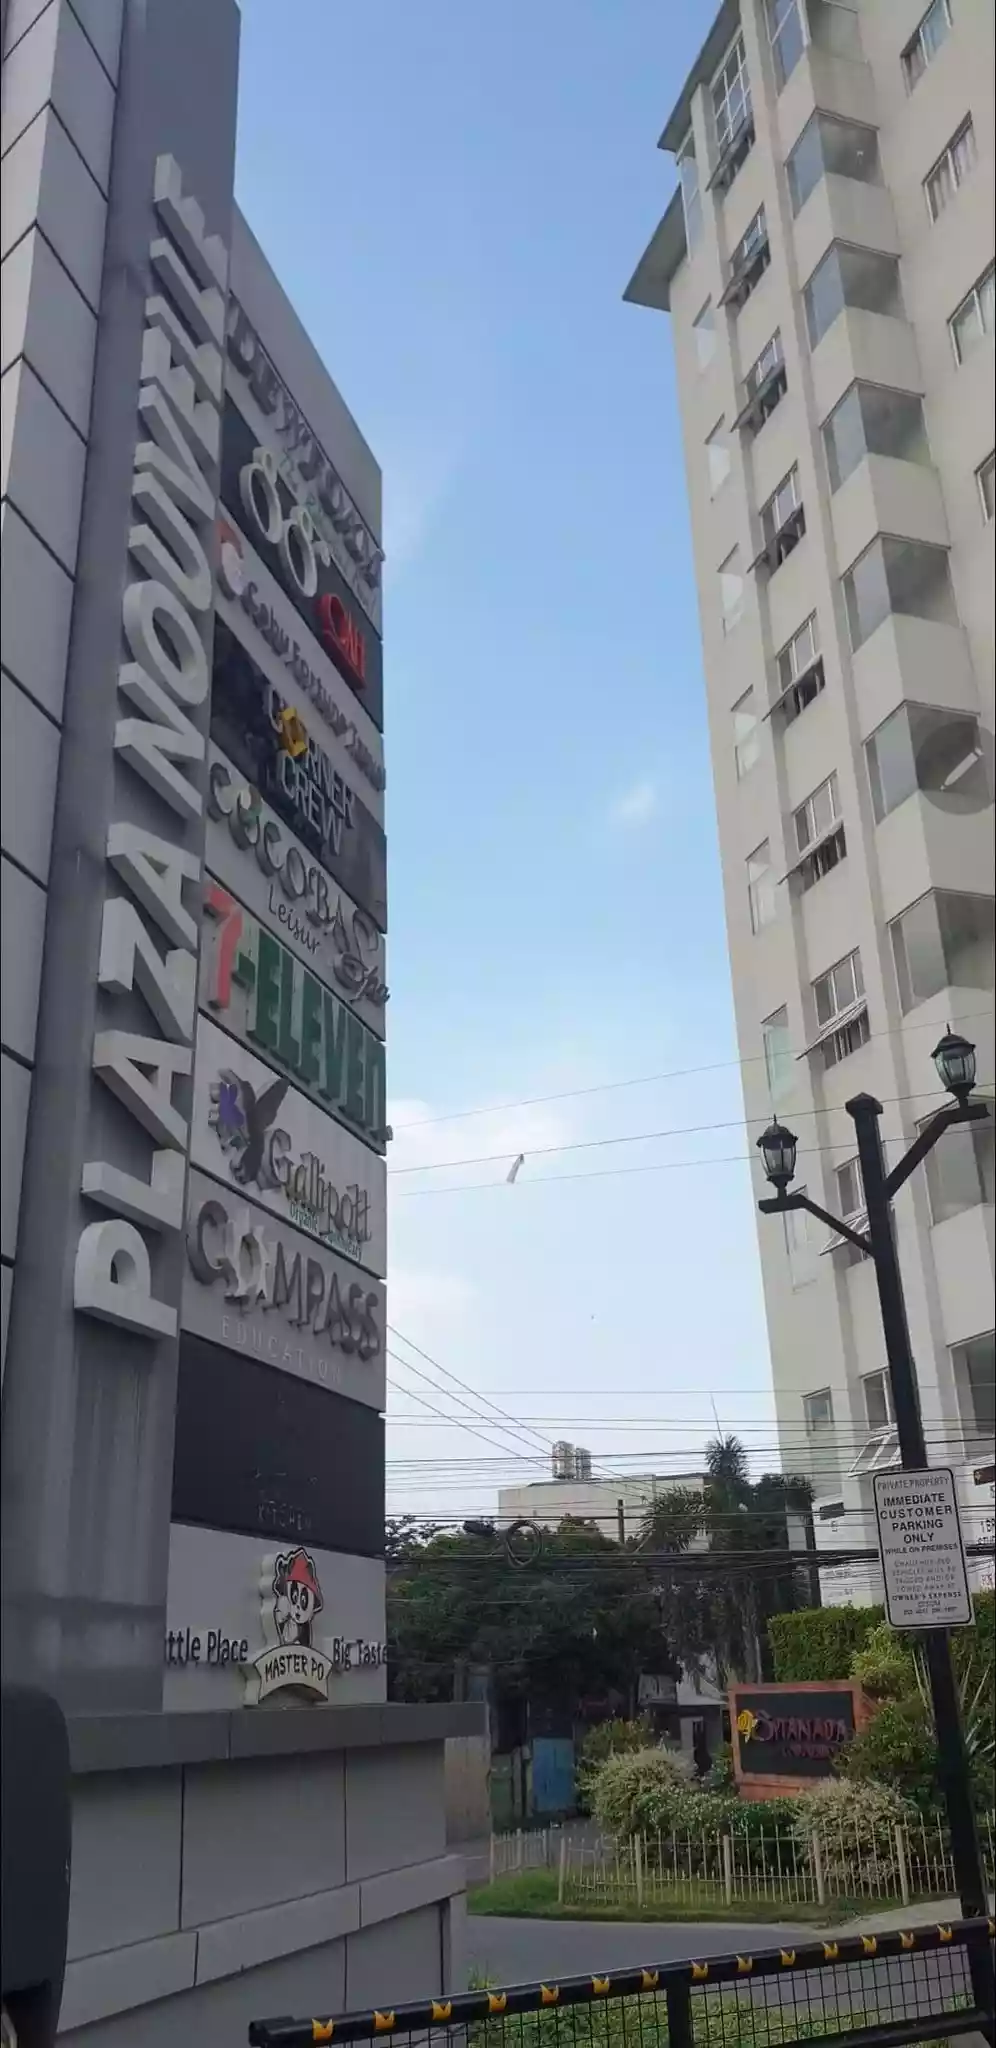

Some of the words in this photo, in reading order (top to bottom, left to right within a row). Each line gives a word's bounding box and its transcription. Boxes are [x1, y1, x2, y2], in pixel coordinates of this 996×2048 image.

[112, 153, 229, 816] NOUVELLE
[281, 755, 344, 857] CREW
[74, 822, 200, 1337] PLAZA
[187, 1200, 380, 1361] COMPASS
[221, 1314, 342, 1384] EDUCATION
[878, 1479, 909, 1491] PRIVATE
[909, 1476, 949, 1488] PROPERTY
[883, 1492, 945, 1507] IMMEDIATE
[880, 1505, 952, 1520] CUSTOMER
[892, 1519, 944, 1532] PARKING
[885, 1546, 908, 1554] WHILE
[920, 1542, 959, 1552] PREMISES
[903, 1532, 934, 1544] ONLY
[207, 1629, 248, 1666] Place
[333, 1636, 351, 1671] Big
[264, 1653, 307, 1682] MASTER
[311, 1658, 324, 1681] PO
